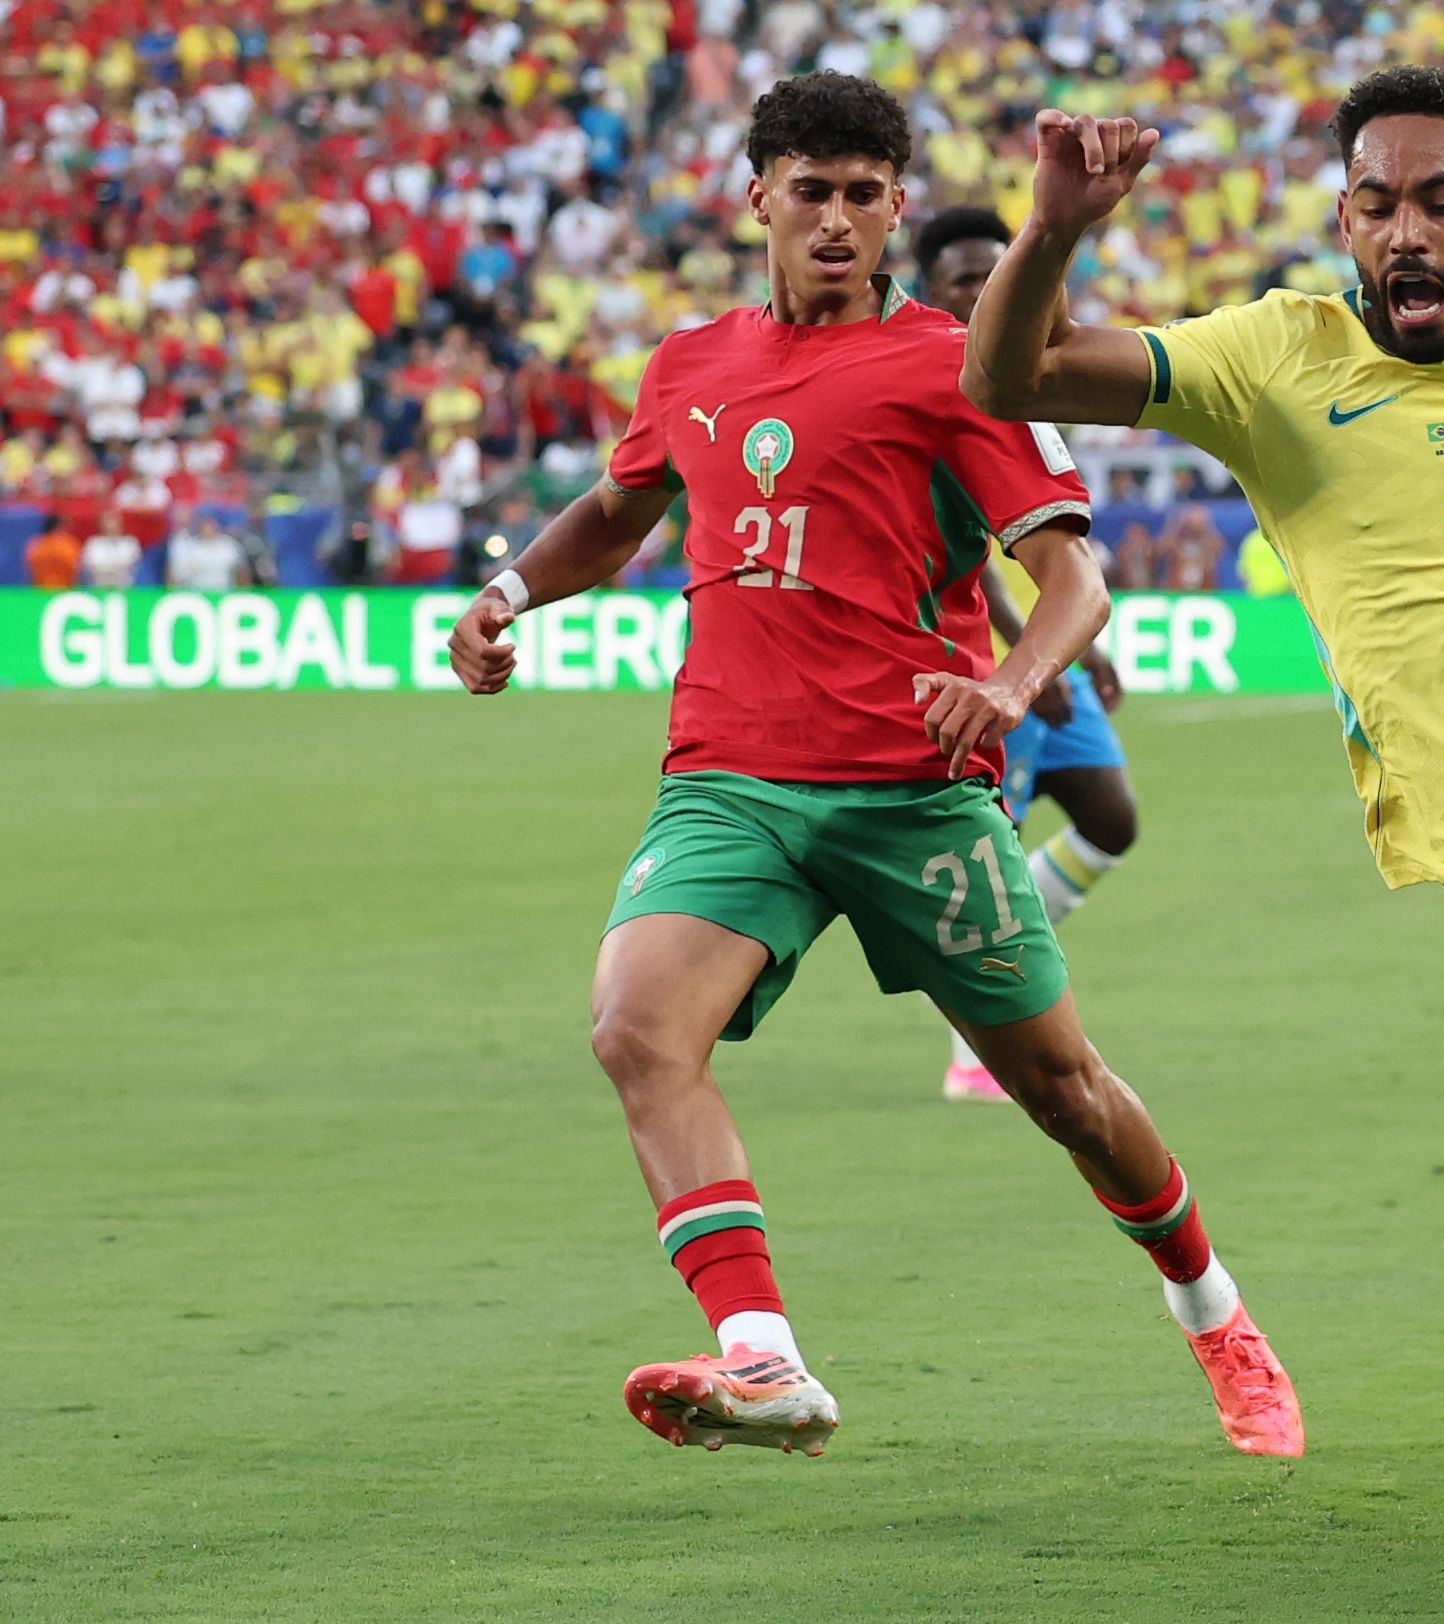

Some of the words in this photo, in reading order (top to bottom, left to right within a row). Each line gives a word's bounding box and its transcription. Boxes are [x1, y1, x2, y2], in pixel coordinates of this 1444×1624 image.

[733, 506, 815, 590] 21
[39, 590, 398, 691] GLOBAL
[1093, 594, 1239, 693] ER
[921, 833, 1024, 957] 21
